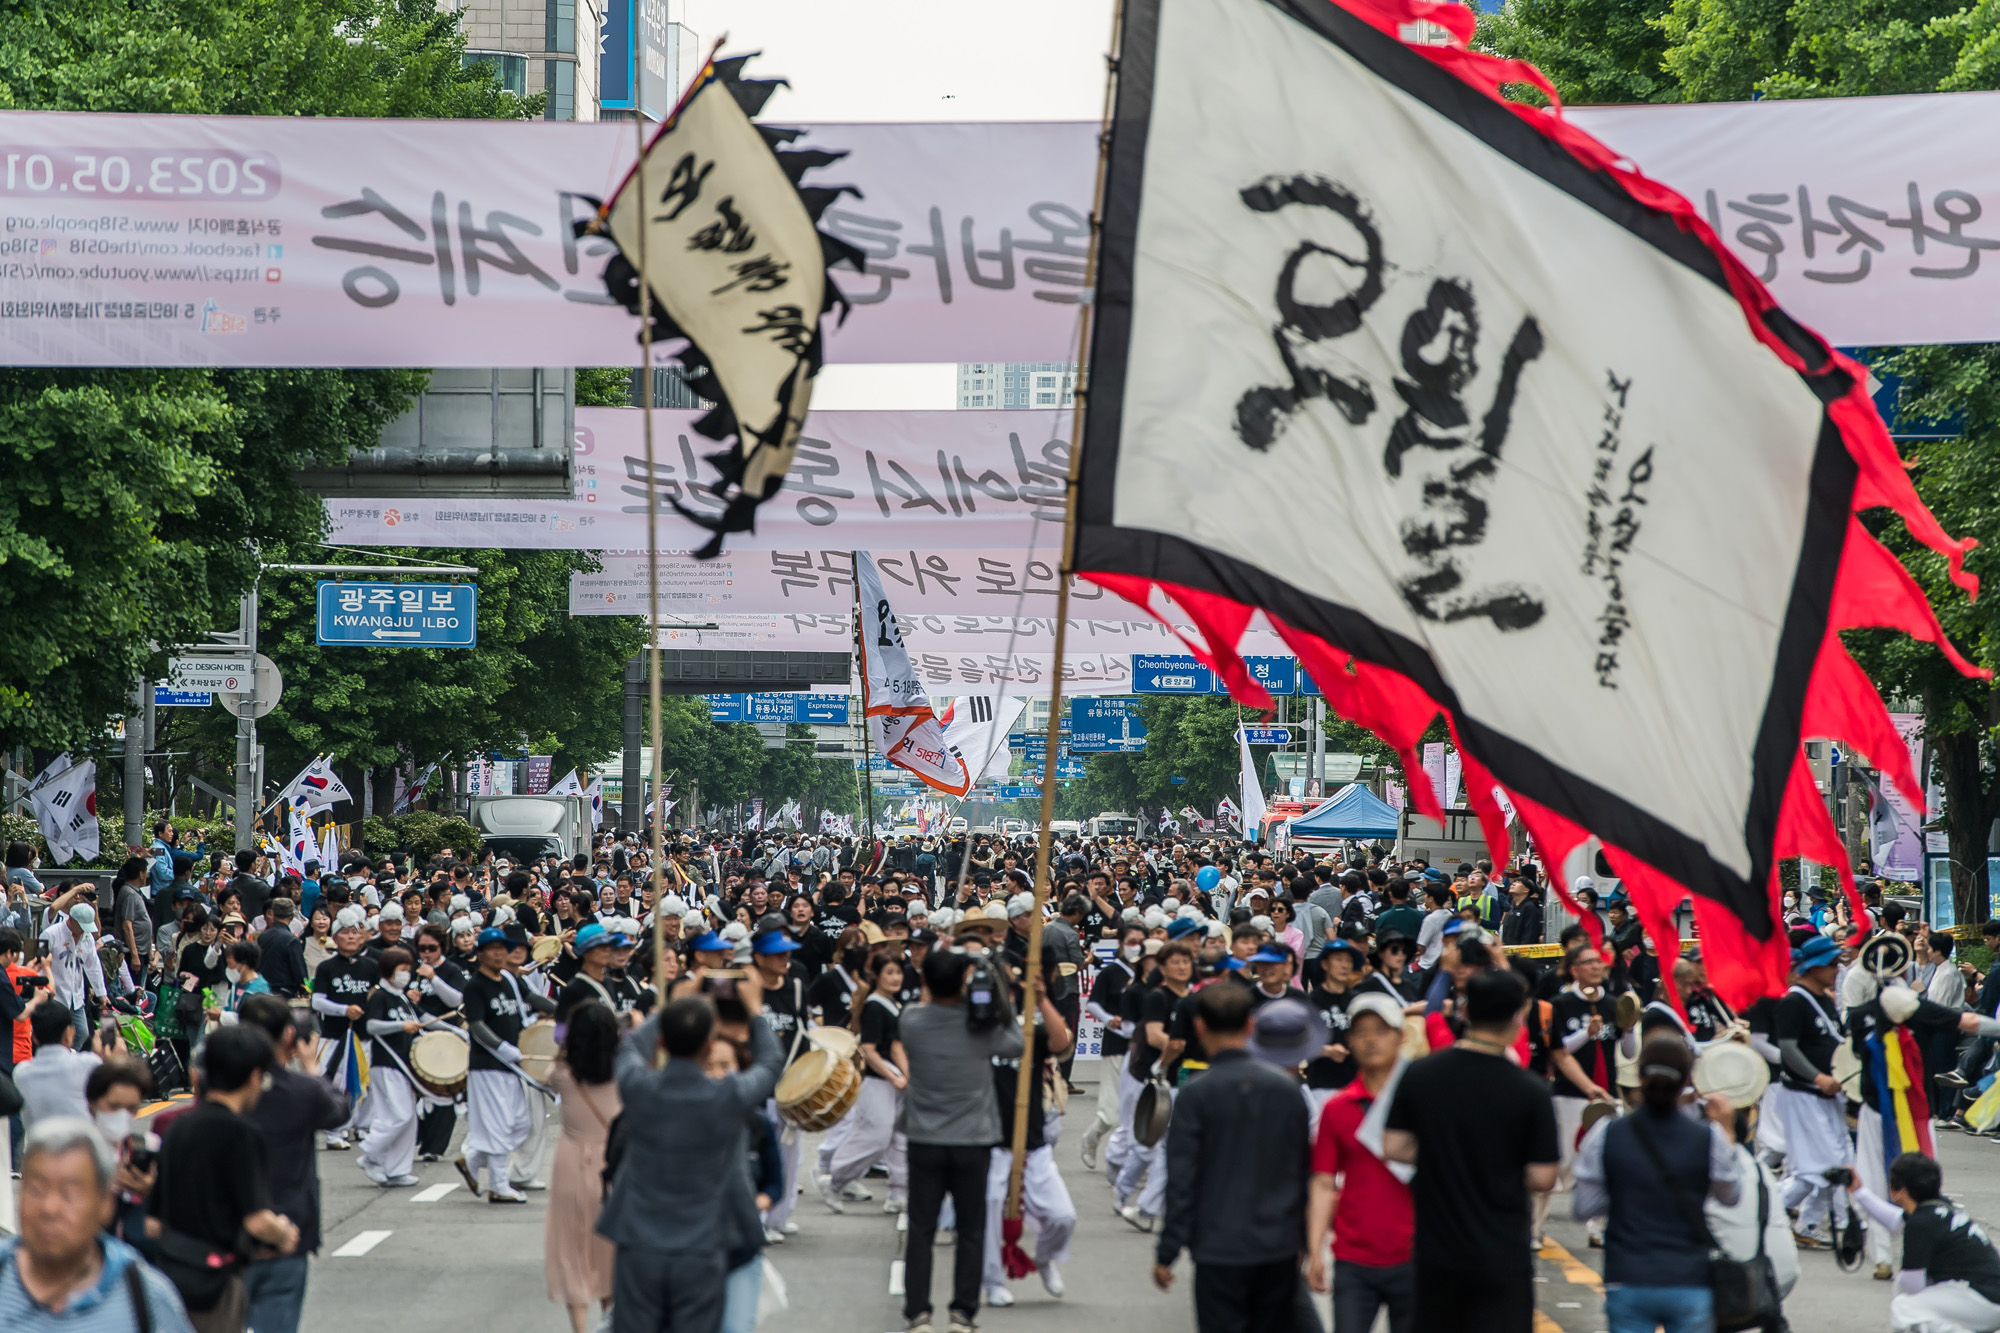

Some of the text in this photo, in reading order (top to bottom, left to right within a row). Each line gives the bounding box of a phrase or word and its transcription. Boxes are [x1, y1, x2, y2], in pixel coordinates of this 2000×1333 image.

[338, 587, 456, 613] 광주일보
[333, 615, 459, 628] KWANGJU ILBO
[195, 663, 223, 671] DESIGN
[1164, 677, 1191, 686] 중앙로
[1263, 680, 1283, 689] Hall
[755, 705, 794, 714] 유동사거리
[807, 702, 846, 711] Expressway
[1087, 708, 1126, 717] 유동사거리
[755, 714, 781, 722] Yudong
[1253, 730, 1273, 738] 중앙로
